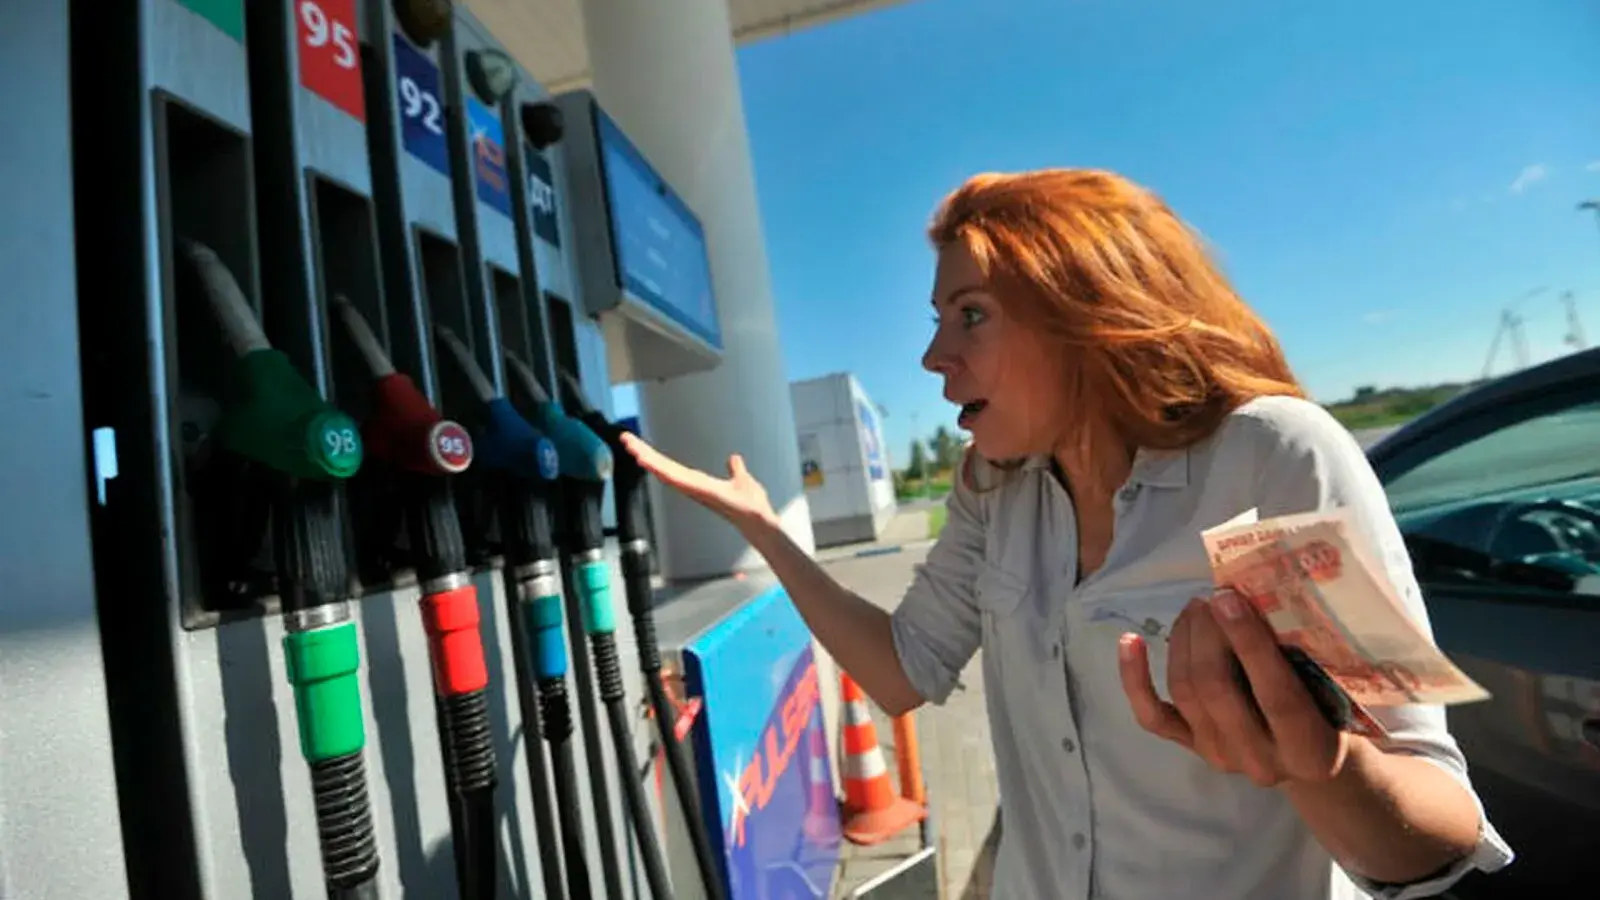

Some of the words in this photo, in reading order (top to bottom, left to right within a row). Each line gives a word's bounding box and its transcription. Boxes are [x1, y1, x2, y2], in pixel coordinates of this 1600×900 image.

[301, 1, 355, 69] 95
[400, 76, 443, 135] 92
[325, 428, 357, 457] 98
[439, 435, 465, 455] 95
